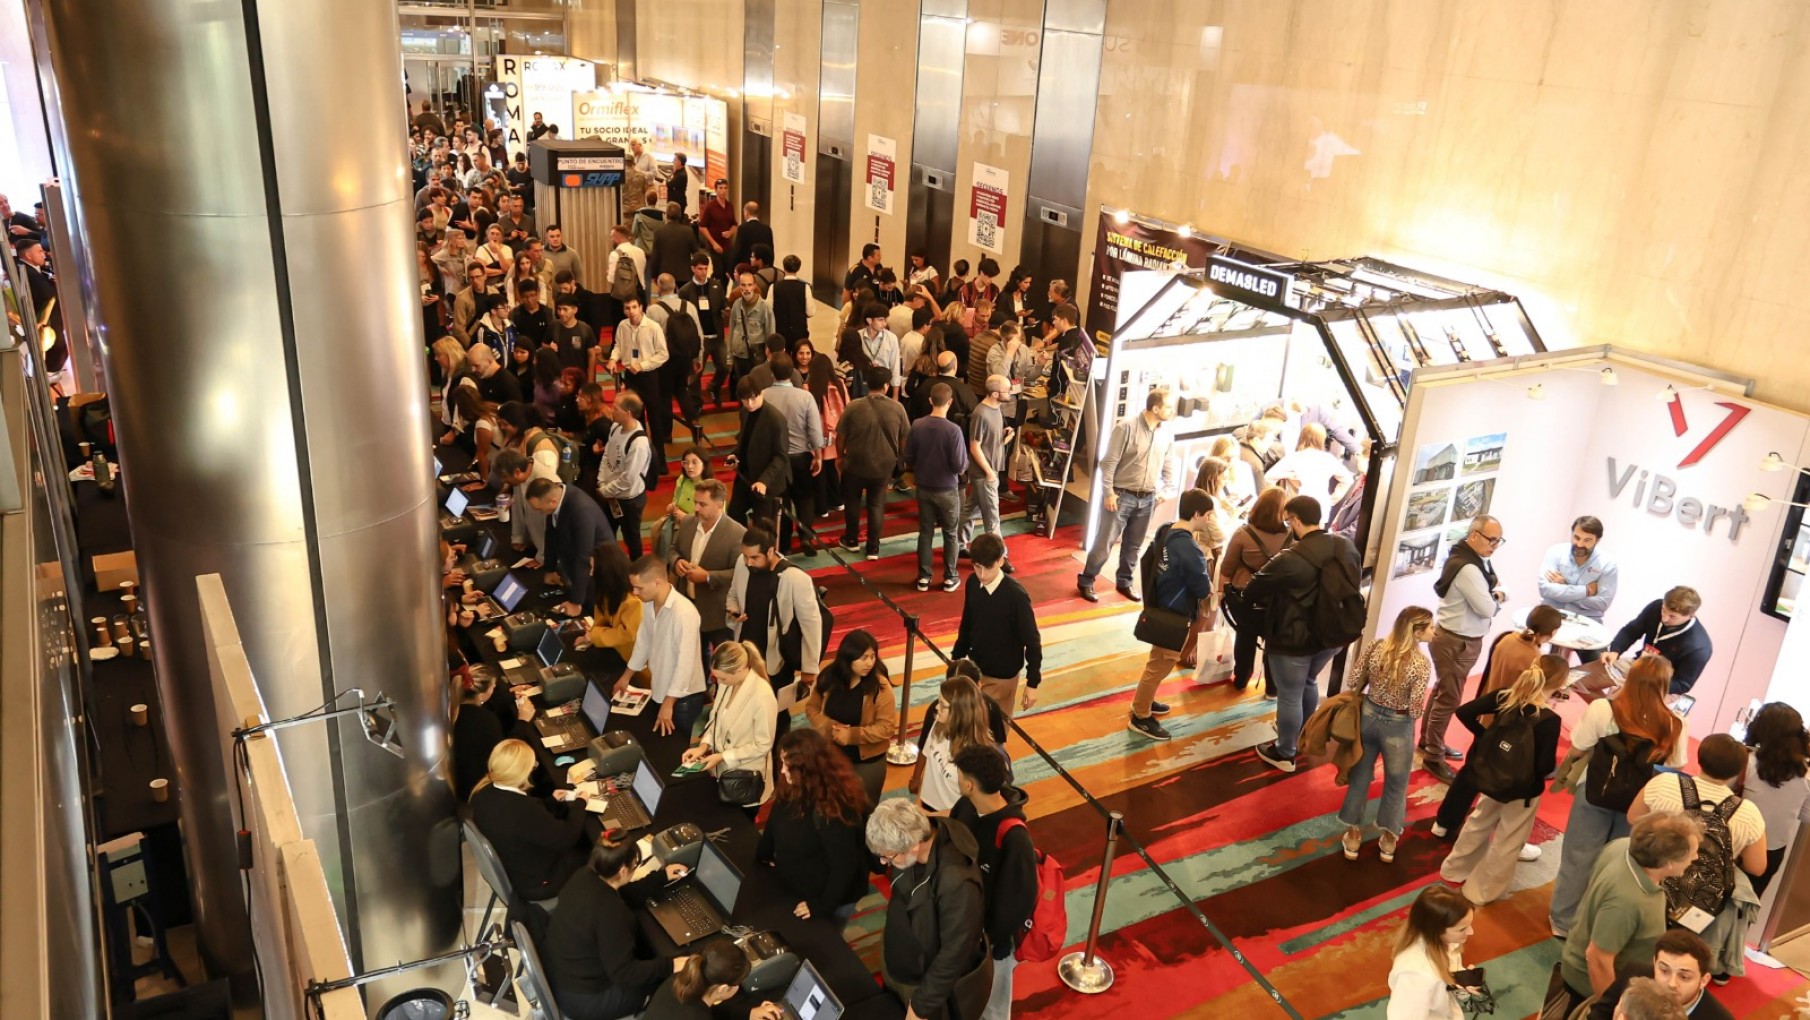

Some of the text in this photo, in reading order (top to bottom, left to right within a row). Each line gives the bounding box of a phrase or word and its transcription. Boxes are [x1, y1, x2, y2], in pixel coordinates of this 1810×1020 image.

[578, 101, 640, 116] Ormiflex
[1106, 231, 1188, 264] SISTEMA DE CALEFACCIÓN
[1106, 245, 1118, 259] POR
[1118, 247, 1143, 267] LÁMINA
[1209, 264, 1277, 297] DEMASLED
[1607, 456, 1750, 542] ViBert
